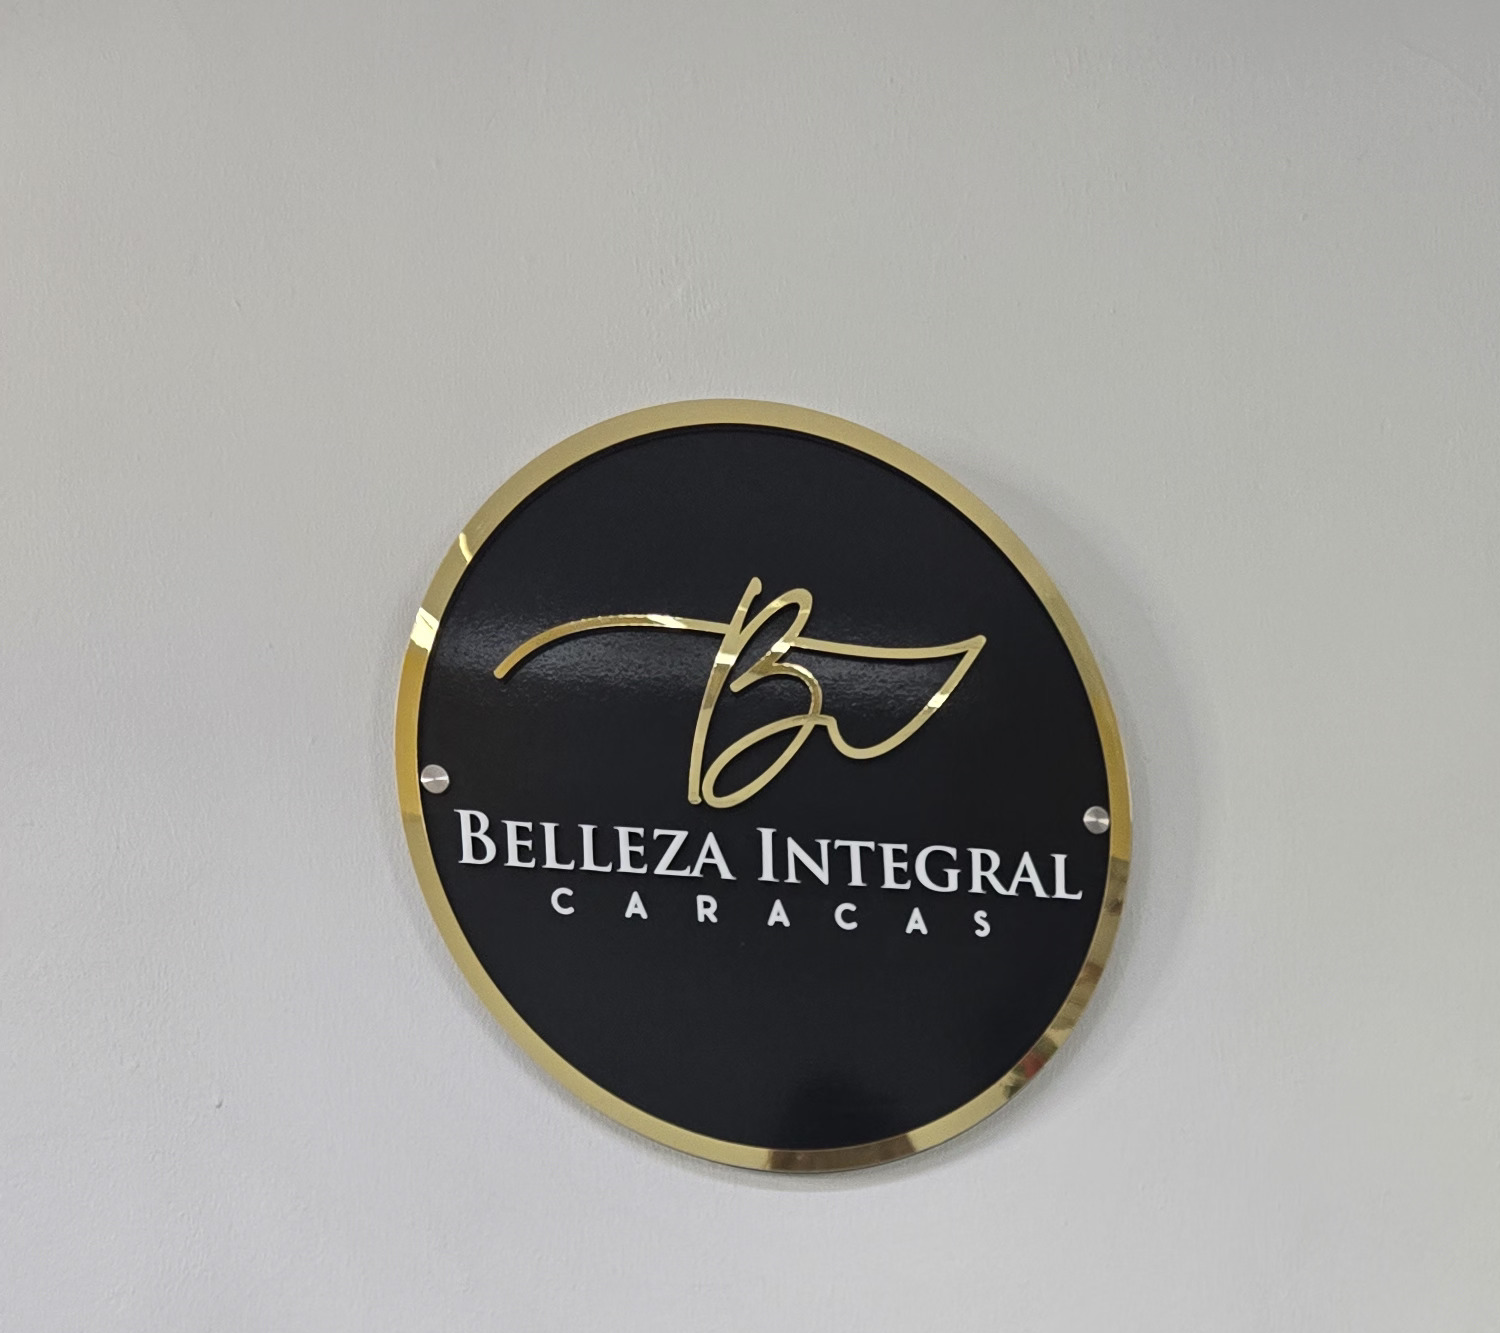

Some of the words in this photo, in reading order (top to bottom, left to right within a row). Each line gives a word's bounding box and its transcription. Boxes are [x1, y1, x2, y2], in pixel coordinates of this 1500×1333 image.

[453, 808, 737, 882] BELLEZA
[756, 826, 1084, 902] INTEGRAL
[549, 886, 992, 938] CARACAS
